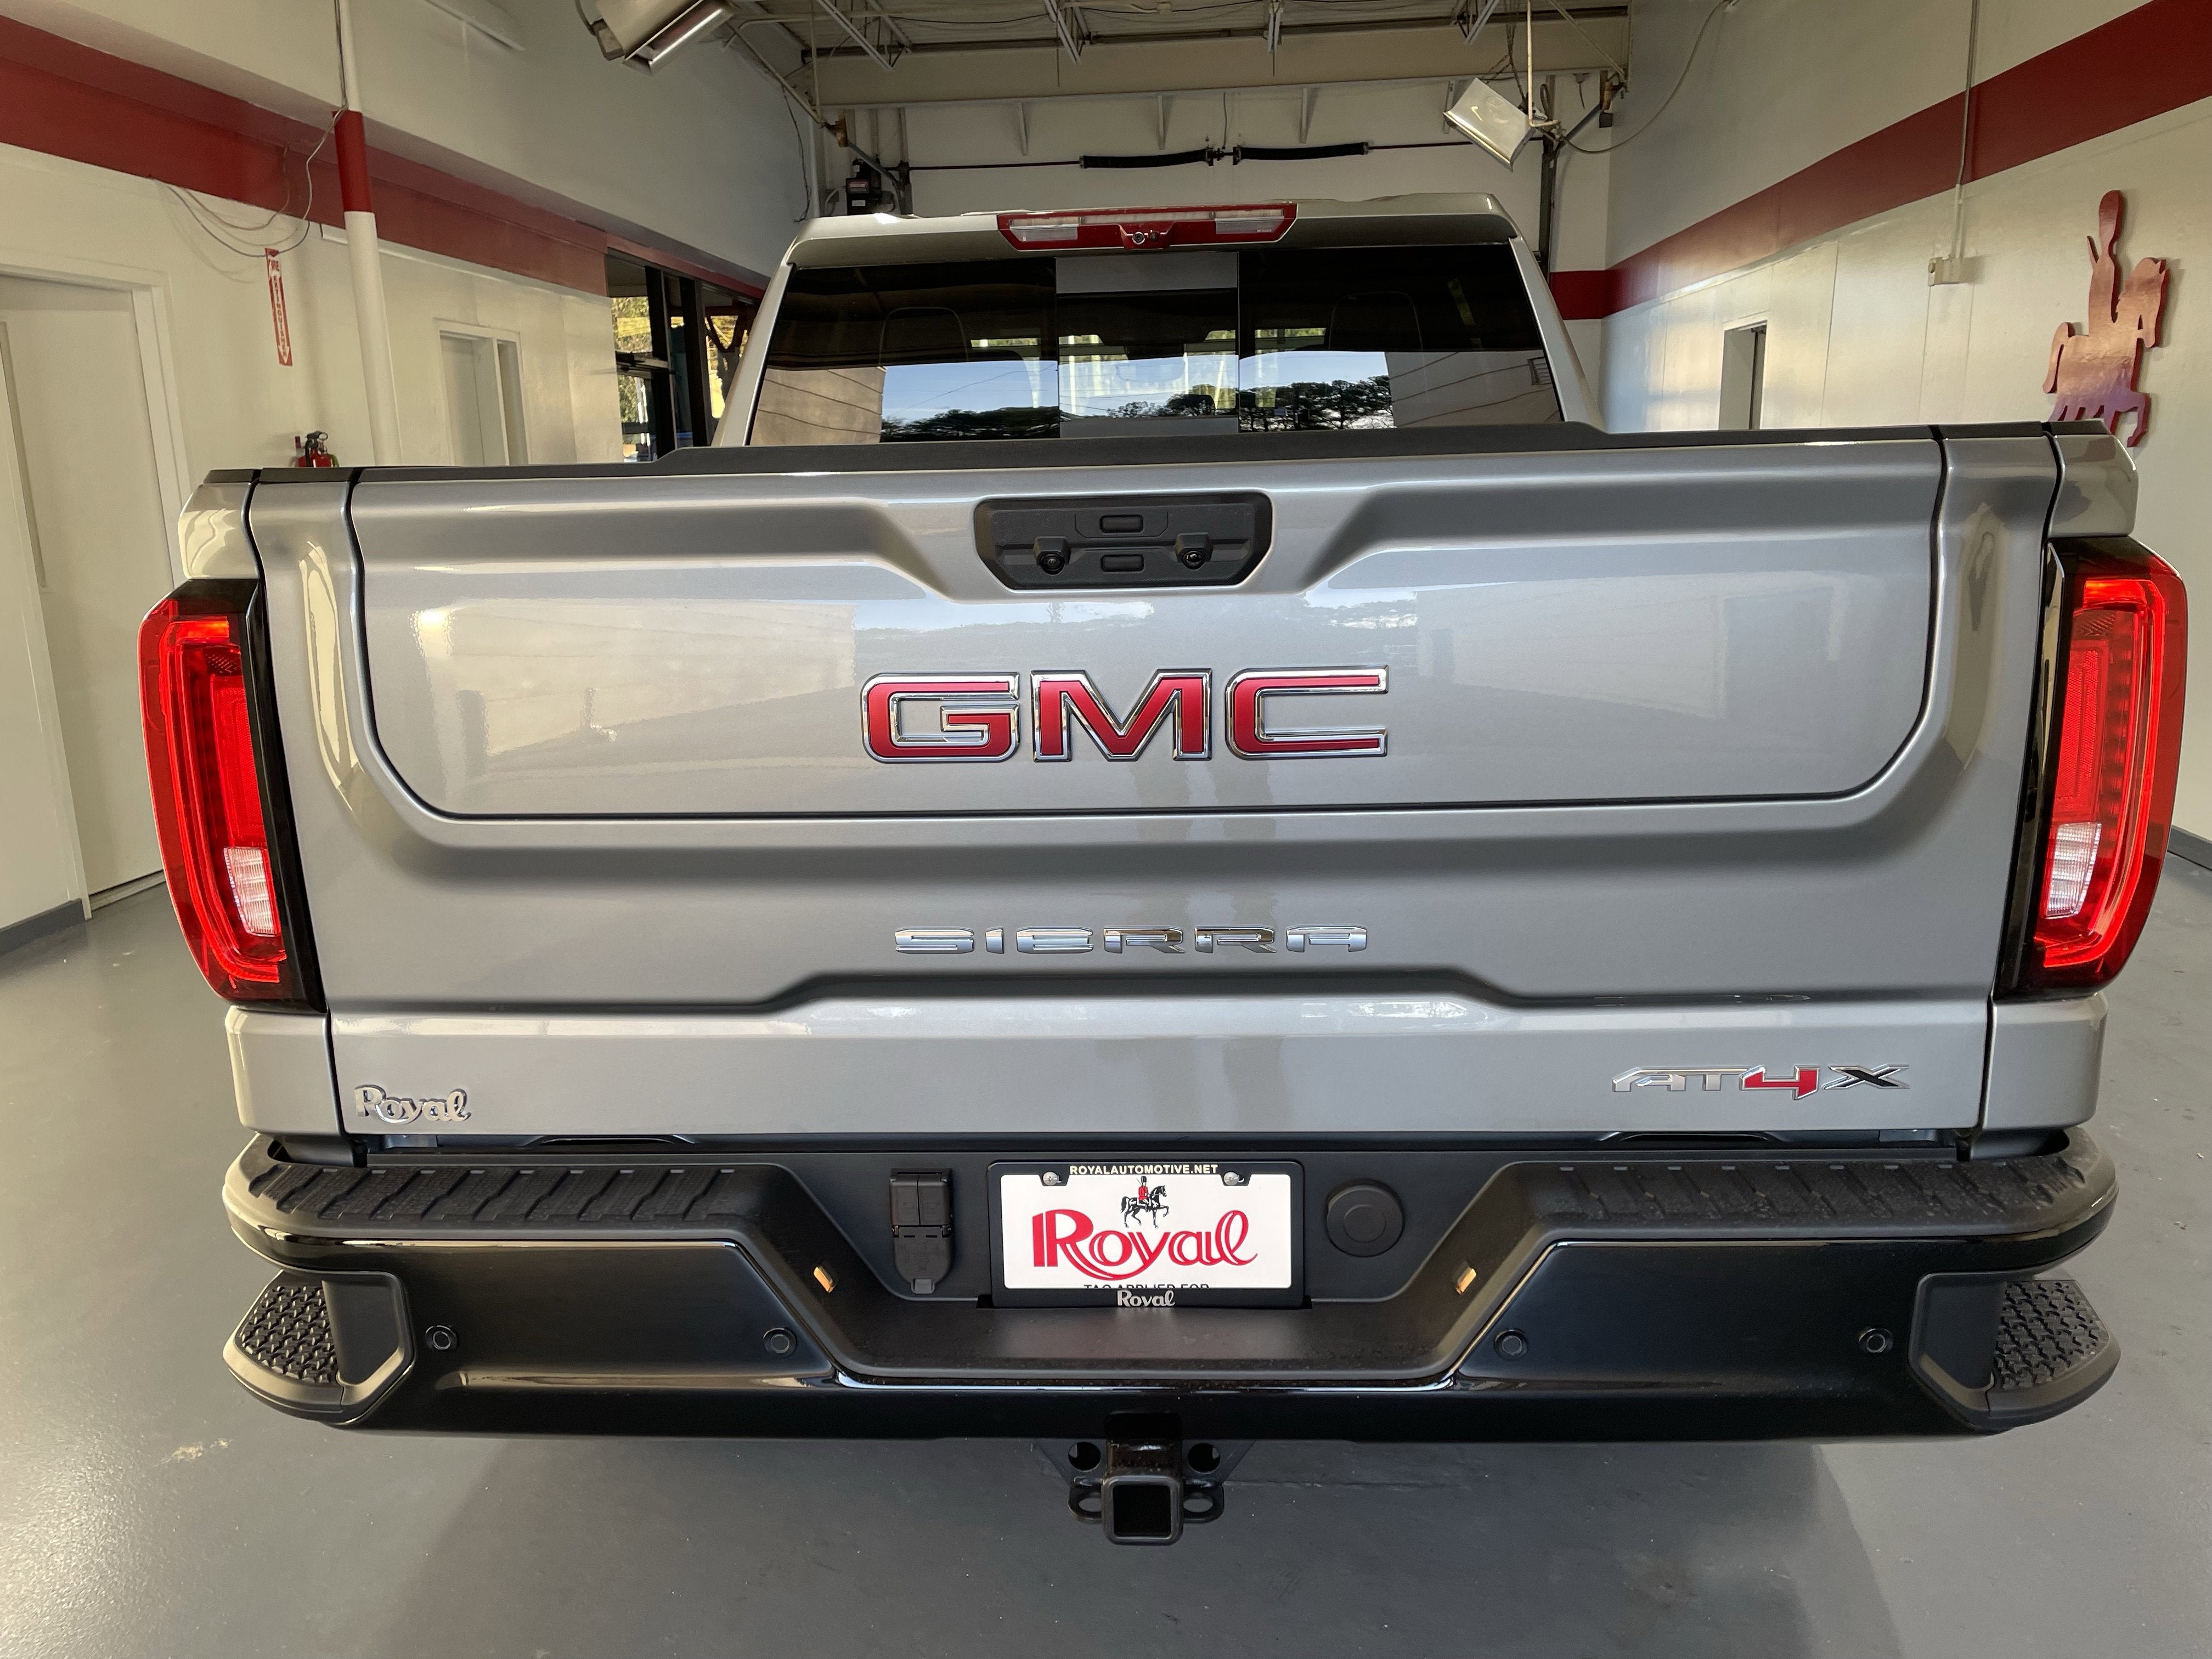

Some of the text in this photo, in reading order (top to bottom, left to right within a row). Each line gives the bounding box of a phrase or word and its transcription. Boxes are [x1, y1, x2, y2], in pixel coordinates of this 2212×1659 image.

[860, 665, 1389, 763] GMC
[894, 924, 1367, 954] SIERRA
[1612, 1064, 1910, 1100] AT4X
[354, 1084, 471, 1125] Royal
[1069, 1164, 1218, 1175] ROYALAUTOMOTIVE.NET
[1032, 1209, 1258, 1281] Royal
[1116, 1289, 1175, 1307] Royal
